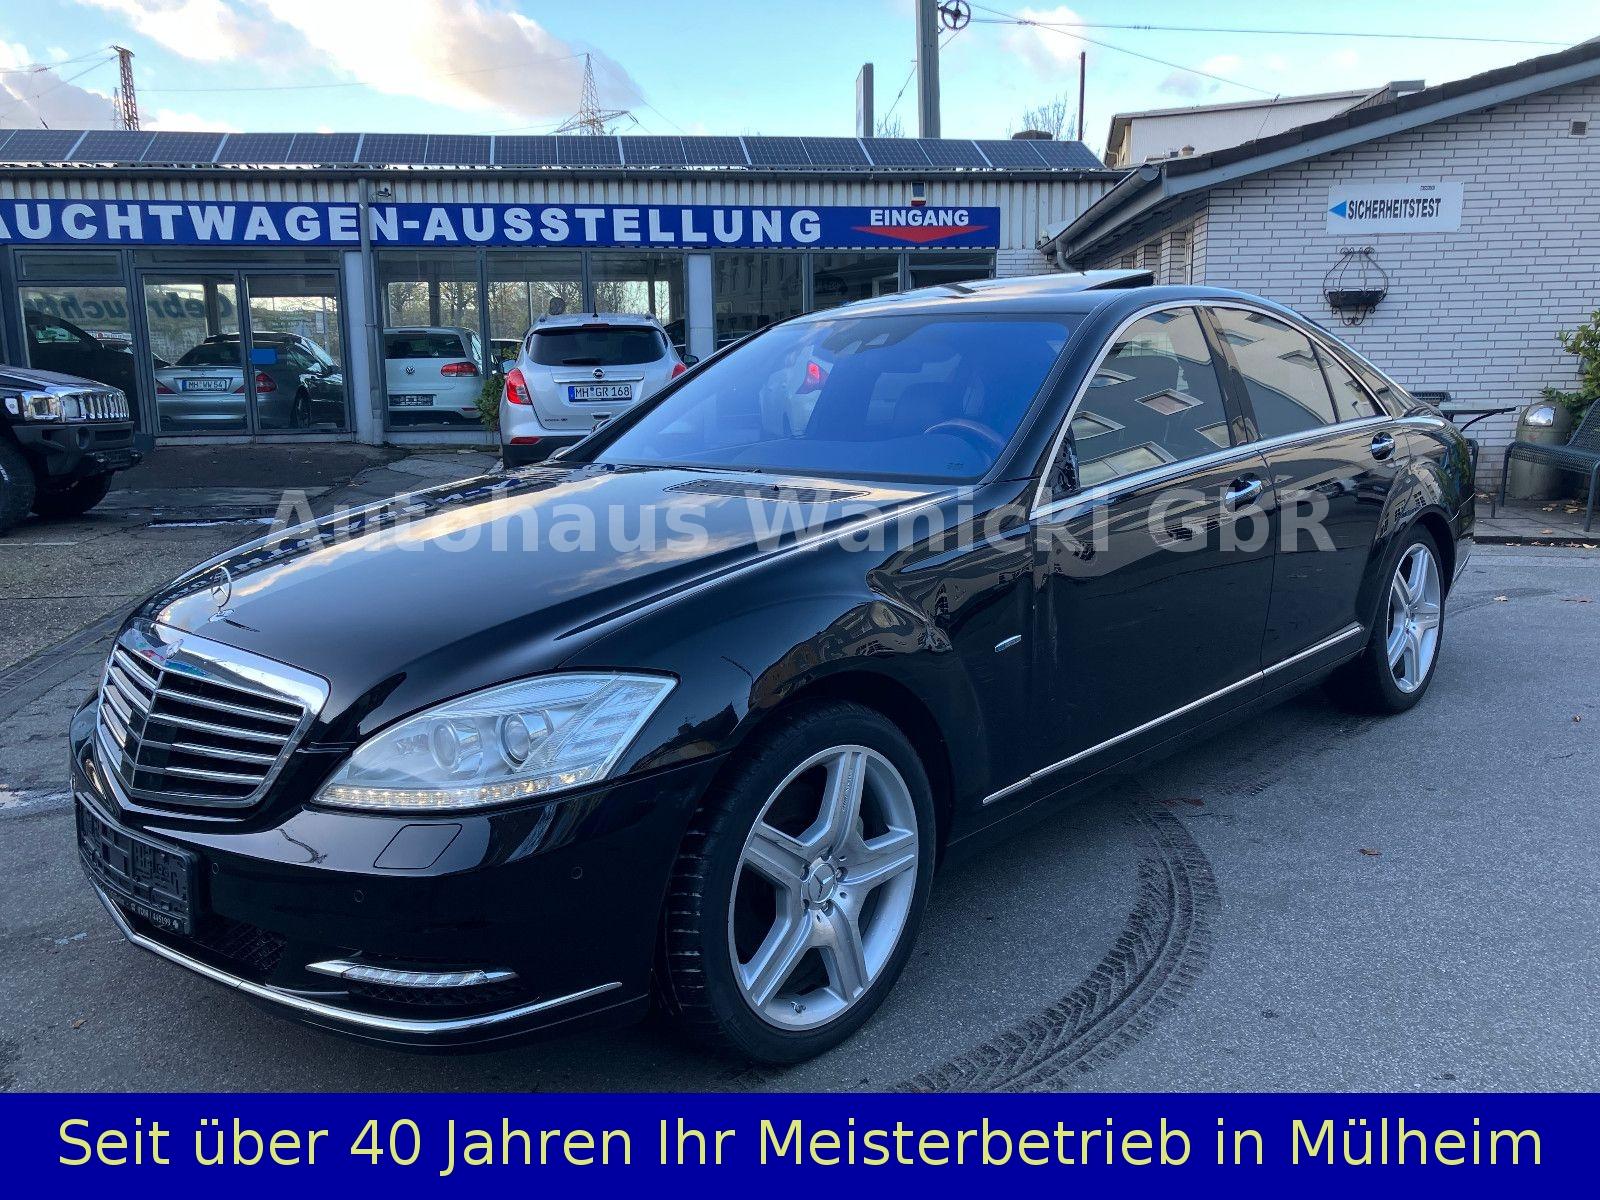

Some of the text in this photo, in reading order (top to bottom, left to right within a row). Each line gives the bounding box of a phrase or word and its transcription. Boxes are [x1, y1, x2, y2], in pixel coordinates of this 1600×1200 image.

[1348, 198, 1441, 219] SICHERHEITSTEST
[870, 209, 969, 227] EINGANG
[575, 386, 630, 397] MH GR 168
